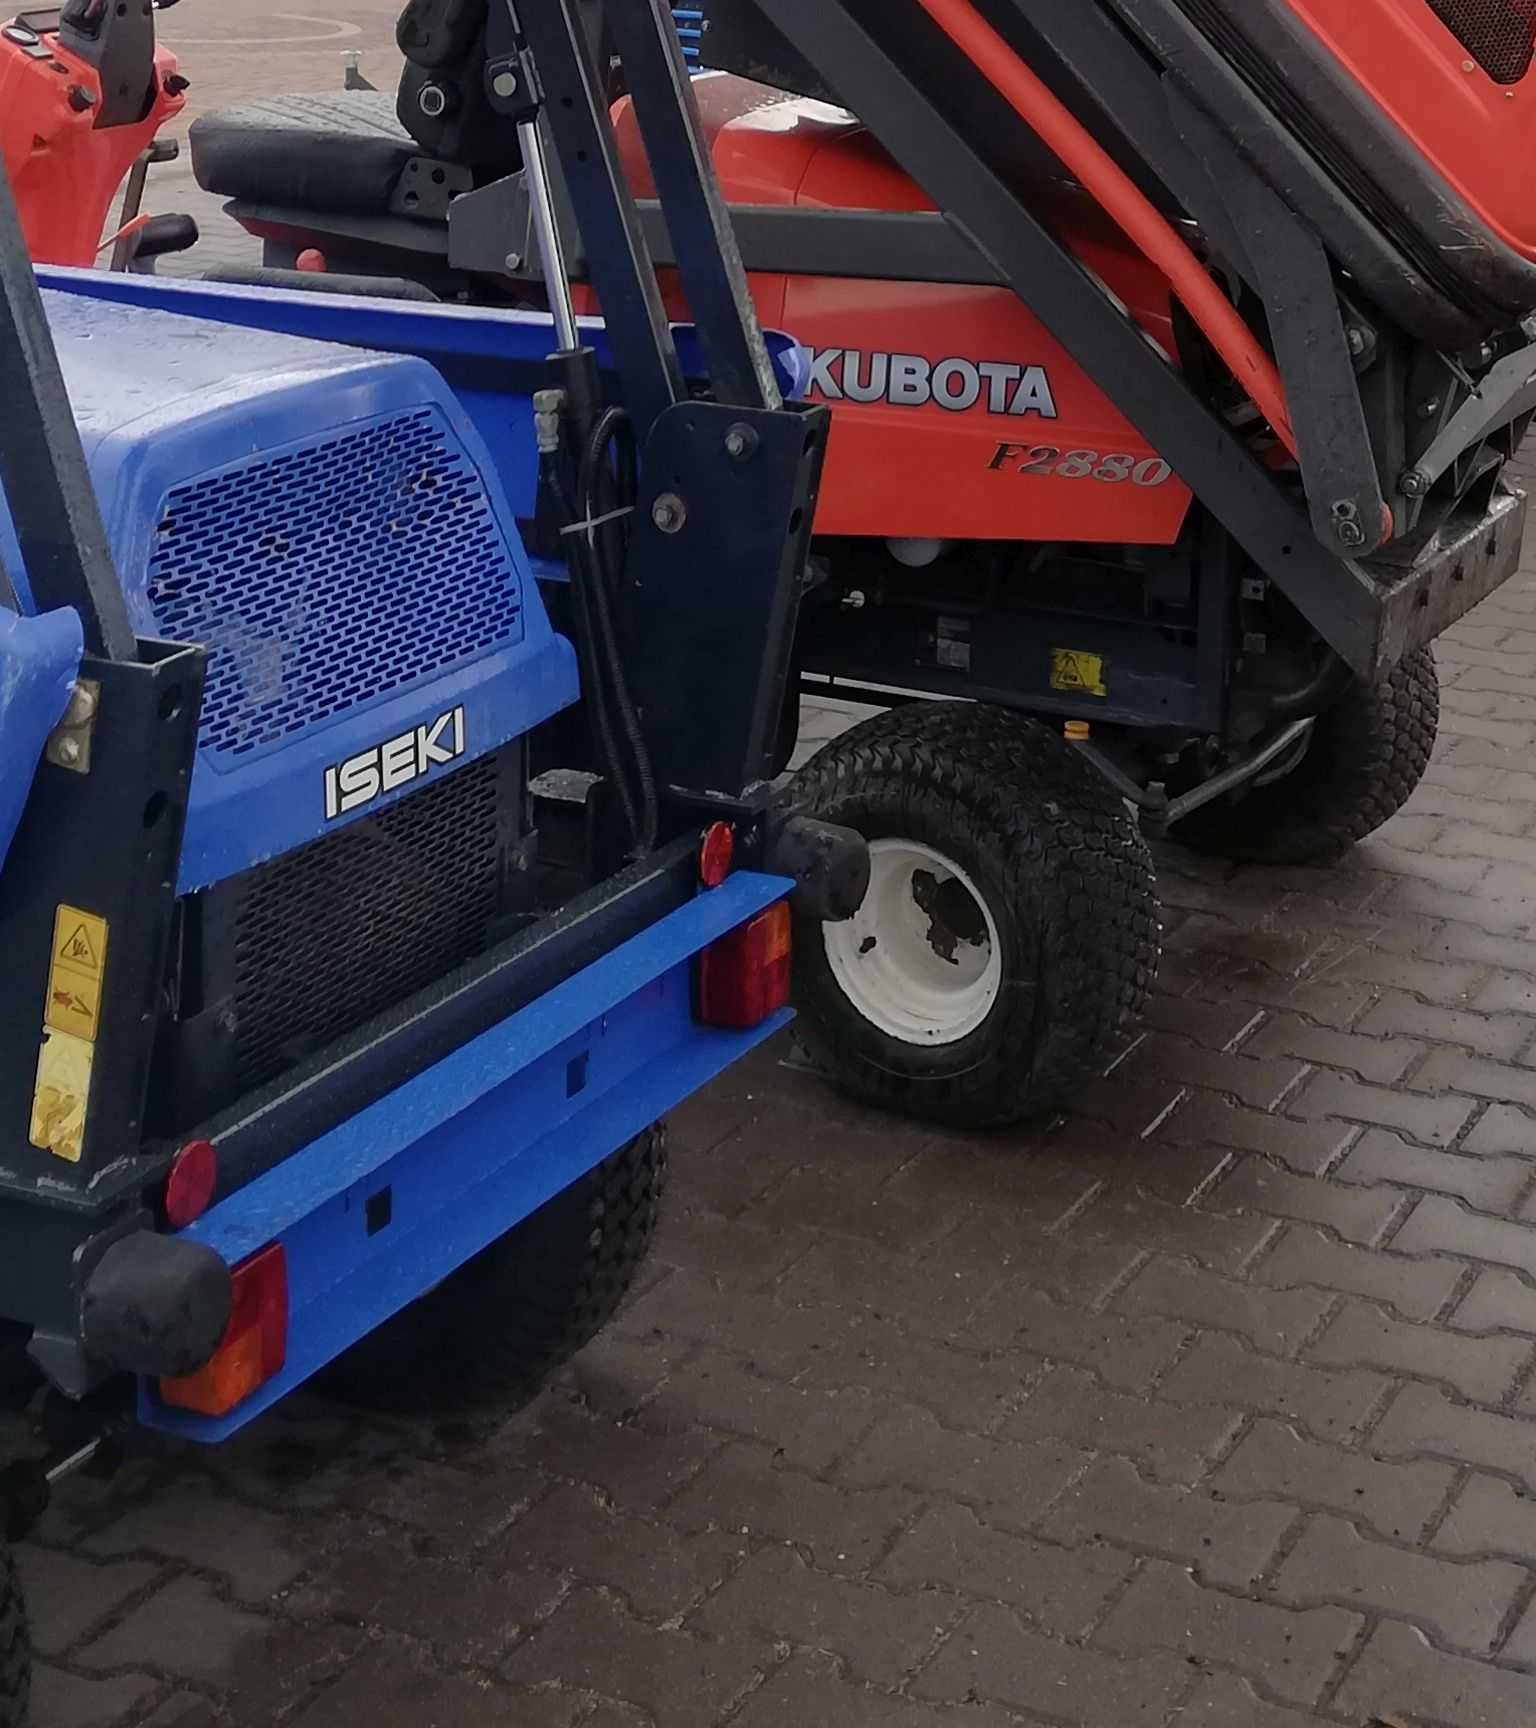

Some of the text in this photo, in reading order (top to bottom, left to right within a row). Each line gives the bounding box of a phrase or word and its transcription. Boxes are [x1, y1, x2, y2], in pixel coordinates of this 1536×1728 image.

[802, 346, 1058, 419] KUBOTA
[985, 440, 1173, 487] F2880
[324, 704, 465, 820] ISEKI
